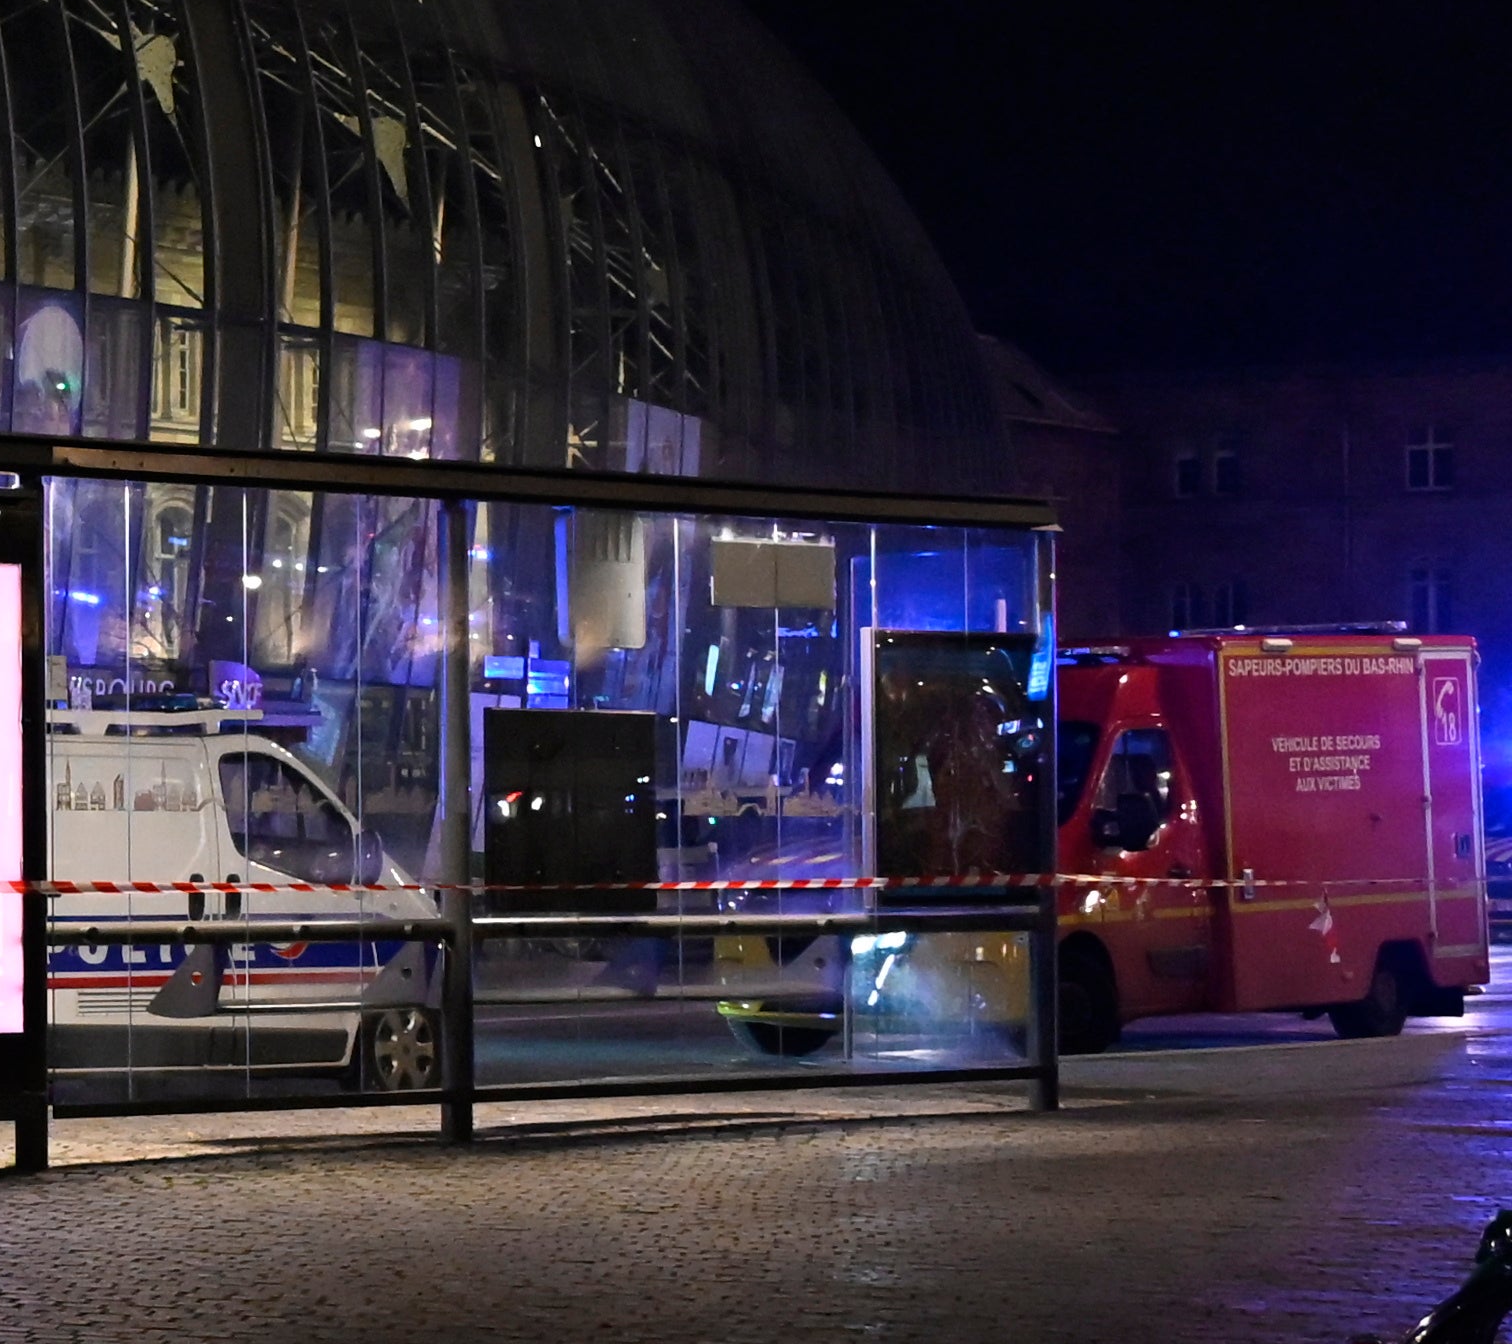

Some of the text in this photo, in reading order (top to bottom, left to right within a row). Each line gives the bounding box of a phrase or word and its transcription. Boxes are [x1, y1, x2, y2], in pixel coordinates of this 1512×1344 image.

[1228, 657, 1414, 676] SAPEURS-POMPIERS DU BAS-RHIN
[1441, 712, 1457, 742] 18
[1321, 736, 1334, 751] DE
[1336, 735, 1381, 750] SECOURS
[1289, 755, 1371, 772] ET D'ASSISTANCE
[1296, 775, 1361, 791] AUX VICTIMES
